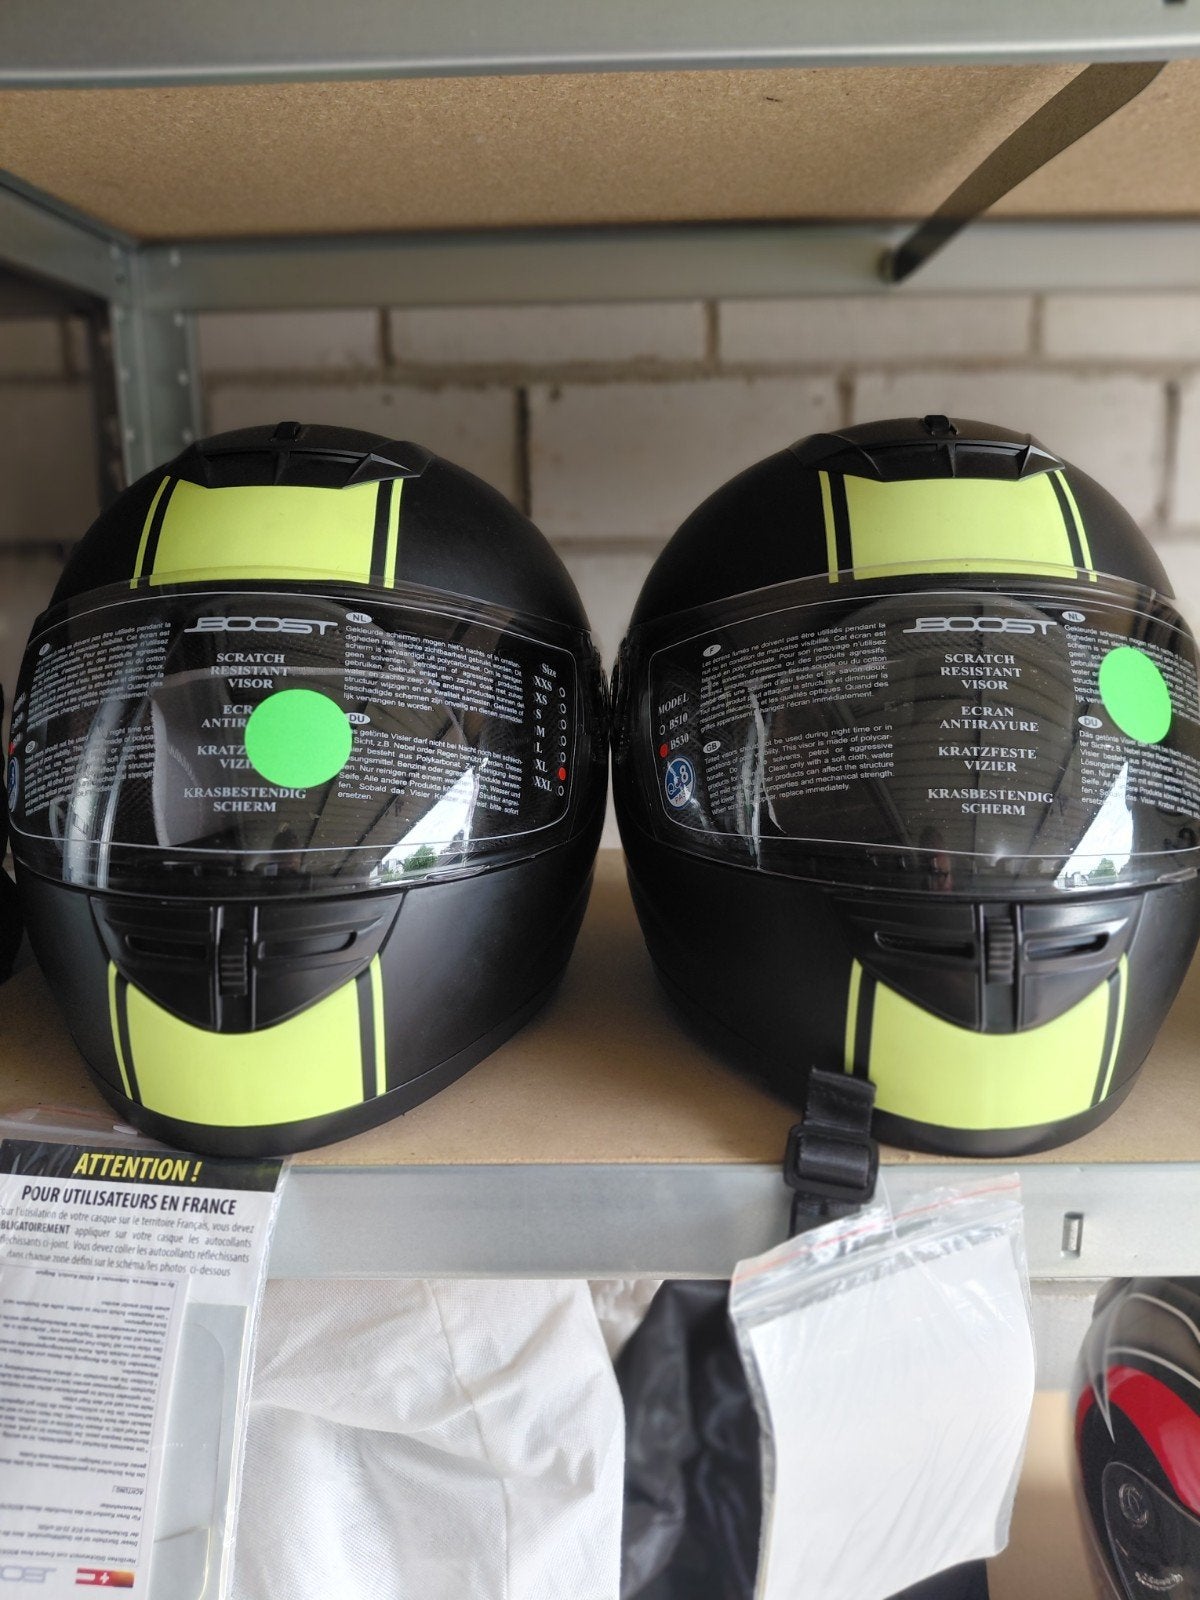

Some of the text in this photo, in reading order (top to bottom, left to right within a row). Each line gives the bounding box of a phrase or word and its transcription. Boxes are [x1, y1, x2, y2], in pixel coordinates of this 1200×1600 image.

[353, 613, 366, 622] NL
[184, 616, 338, 635] BOOST
[845, 623, 876, 633] pendant
[903, 616, 1057, 635] BOOST
[346, 625, 446, 648] Gekleurde schermen mogen
[346, 634, 380, 644] digheden
[345, 642, 373, 651] scherm
[814, 643, 850, 654] nettoyage
[216, 653, 285, 664] SCRATCH
[816, 652, 845, 662] produits
[944, 654, 1015, 664] SCRATCH
[210, 666, 290, 676] RESISTANT
[542, 663, 556, 678] Size
[940, 666, 1022, 678] RESISTANT
[228, 678, 273, 689] VISOR
[534, 675, 552, 691] XXS
[801, 673, 878, 688] structure diminuer
[845, 682, 871, 691] Quand
[961, 680, 1008, 690] VISOR
[344, 684, 392, 697] beschadigde
[535, 692, 548, 705] XS
[658, 692, 690, 716] MODEL
[223, 704, 253, 715] ECR
[407, 702, 435, 712] worden.
[961, 706, 1014, 716] ECRAN
[350, 714, 365, 722] DU
[536, 708, 542, 720] S
[201, 717, 247, 728] ANTIR
[669, 712, 688, 730] B510
[939, 719, 1039, 732] ANTIRAYURE
[1084, 718, 1098, 726] DU
[391, 733, 411, 742] Visier
[536, 725, 545, 738] M
[785, 725, 870, 743] used during night time
[394, 742, 415, 751] Nebel
[670, 732, 689, 751] B530
[782, 733, 893, 752] This visor made polycar-
[197, 744, 246, 756] KRATZ
[367, 748, 395, 758] besteht
[536, 742, 542, 754] L
[773, 742, 893, 763] solvents, petrol aggressive
[938, 746, 1037, 760] KRATZFESTE
[220, 758, 251, 769] VIZI
[397, 760, 426, 770] Benzine
[535, 758, 548, 772] XL
[768, 751, 894, 773] Clean only with soft cloth, water
[964, 760, 1017, 772] VIZIER
[376, 767, 406, 778] reinigen
[775, 770, 804, 782] products
[807, 768, 819, 776] can
[822, 764, 842, 774] affect
[859, 761, 894, 769] structure
[409, 780, 442, 791] Produkte
[534, 776, 552, 792] XXL
[766, 781, 798, 792] properties
[816, 773, 858, 783] mechanical
[860, 771, 895, 779] strength.
[184, 787, 306, 799] KRASBESTENDIG
[359, 783, 430, 798] Sobald Visier
[779, 788, 804, 798] replace
[928, 788, 1054, 803] KRASBESTENDIG
[213, 801, 276, 812] SCHERM
[961, 803, 1026, 816] SCHERM
[73, 1152, 202, 1182] ATTENTION !
[21, 1185, 237, 1215] POUR UTILISATEURS EN FRANCE
[59, 1212, 68, 1220] de
[70, 1213, 89, 1221] votre
[91, 1214, 116, 1225] casque
[132, 1216, 139, 1225] le
[141, 1217, 175, 1228] territoire
[212, 1223, 230, 1231] vous
[231, 1222, 254, 1234] devez
[0, 1219, 252, 1248] BLIGATOIREMENT appliquer sur votre casque les autocollants
[73, 1240, 90, 1251] Vous
[92, 1243, 113, 1253] devez
[137, 1245, 146, 1256] les
[148, 1248, 195, 1260] autocollants
[107, 1258, 114, 1267] le
[159, 1264, 186, 1274] photos
[190, 1265, 231, 1277] ci-dessous
